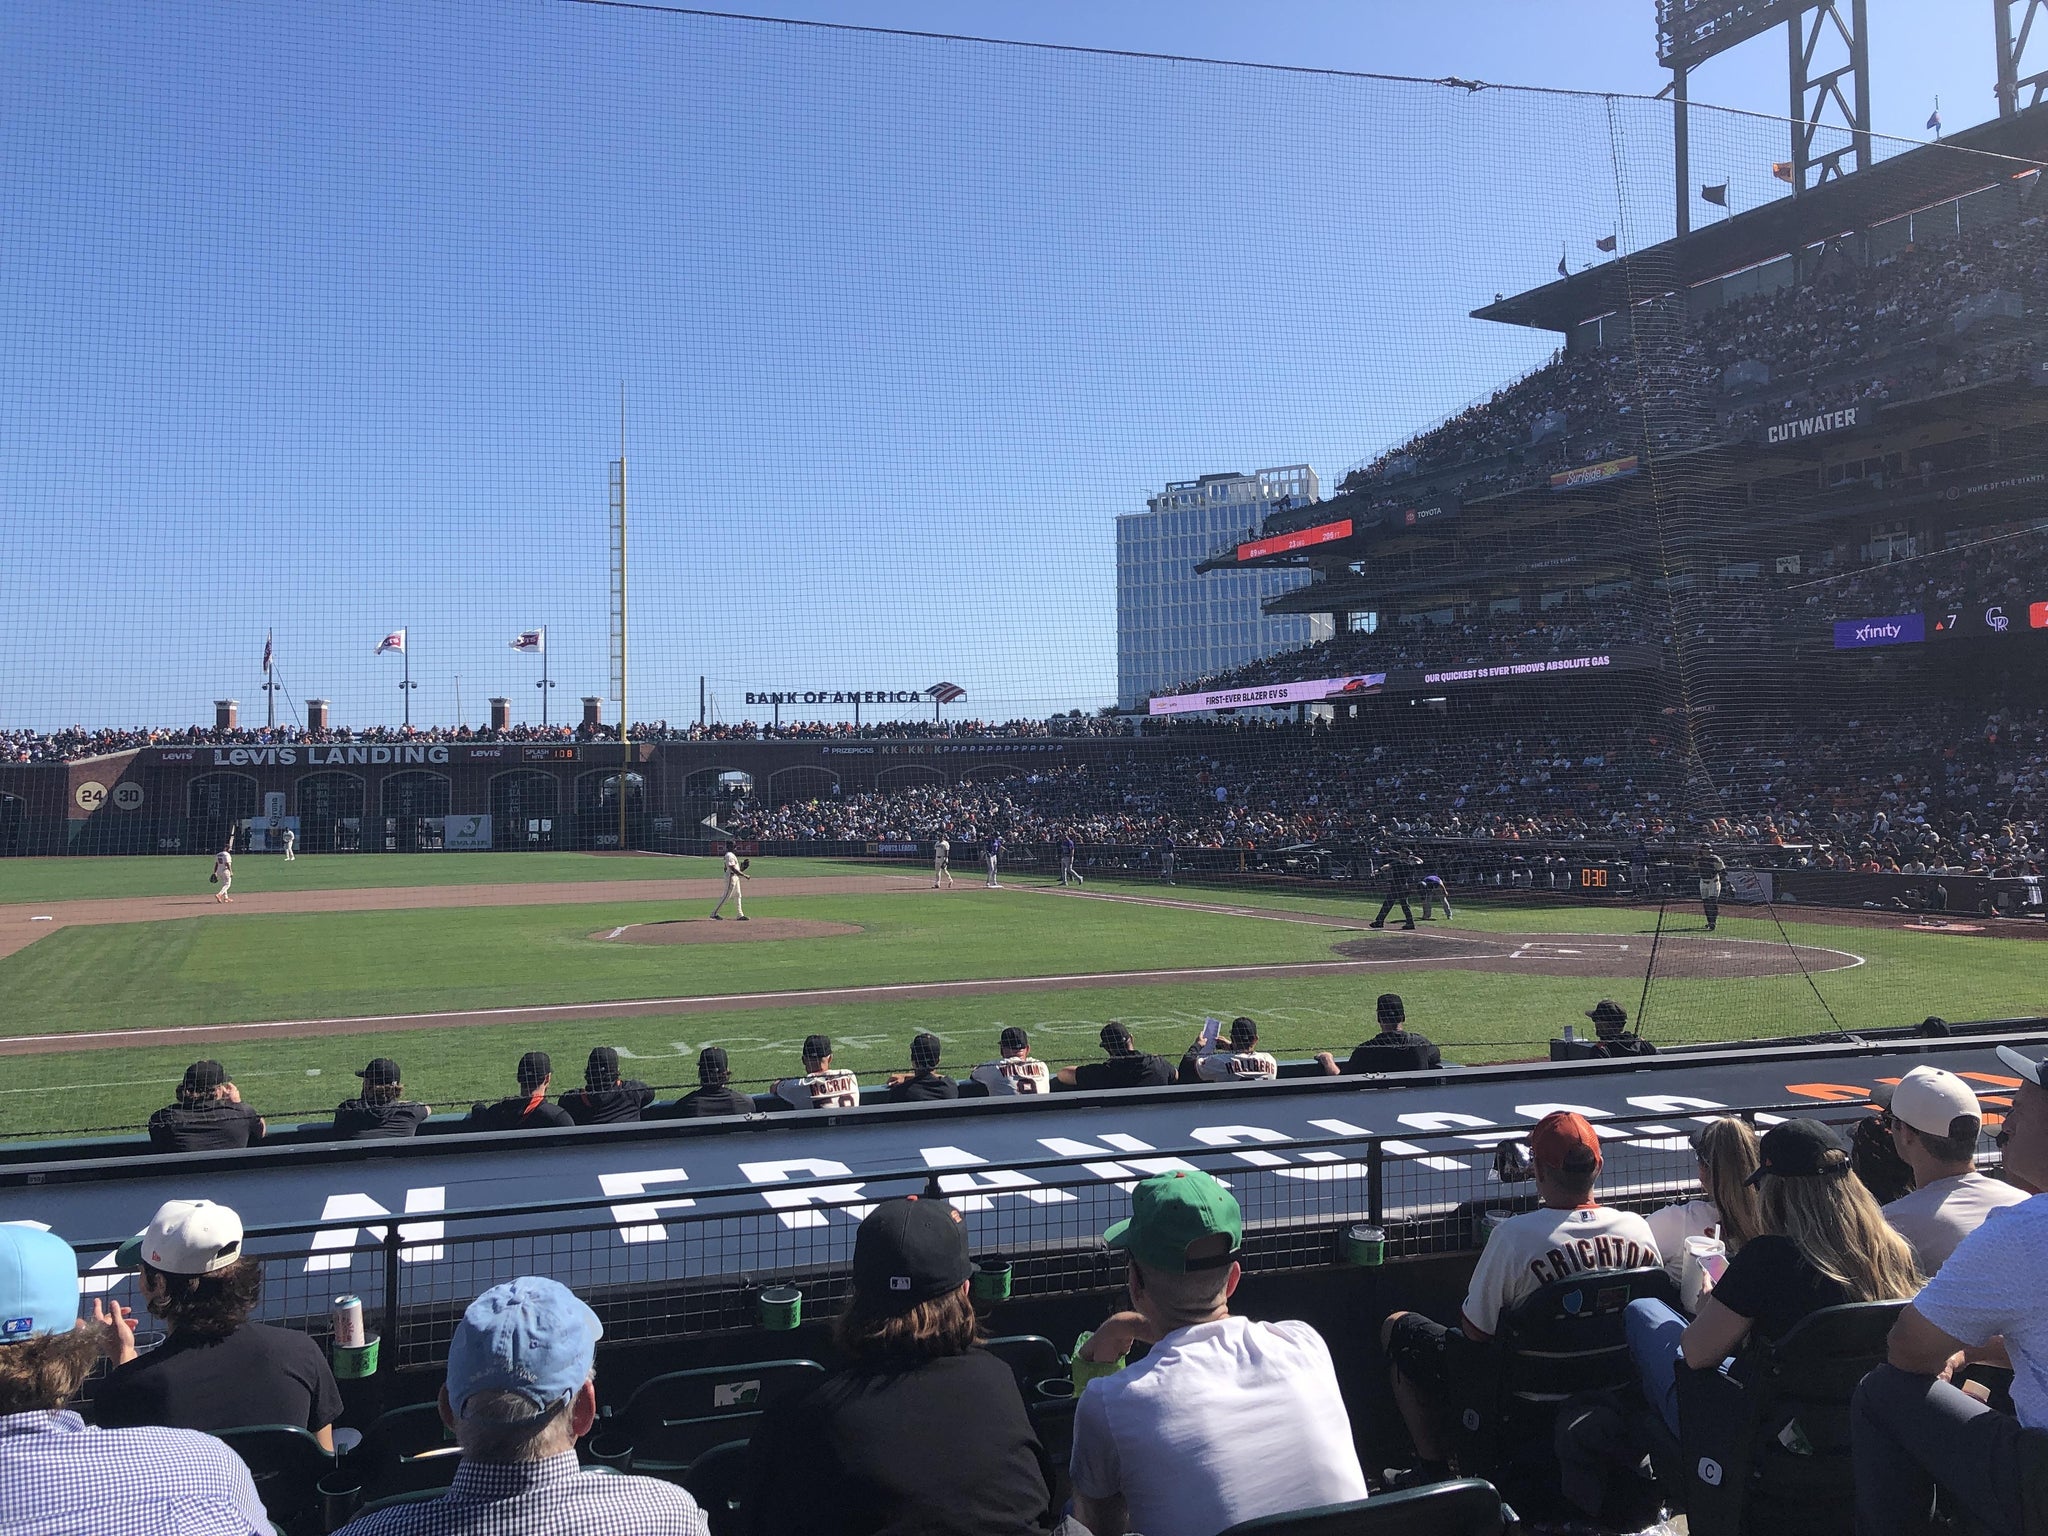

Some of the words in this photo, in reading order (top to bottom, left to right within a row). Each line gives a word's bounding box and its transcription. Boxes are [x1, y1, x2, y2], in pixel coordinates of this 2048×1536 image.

[1768, 407, 1856, 443] CUTWATER
[1566, 466, 1601, 486] Surfside
[1417, 507, 1442, 519] TOYOTA
[1947, 614, 1957, 629] 7
[1855, 623, 1901, 642] xfinity
[1425, 673, 1440, 683] OUR
[1441, 669, 1477, 682] QUICKEST
[1478, 668, 1488, 678] SS
[1489, 666, 1510, 676] EVER
[1510, 663, 1545, 674] THROWS
[1546, 658, 1590, 671] ABSOLUTE
[1592, 656, 1610, 666] GAS
[745, 692, 798, 704] BANK
[803, 692, 828, 704] OF
[833, 691, 920, 703] AMERICA
[1206, 693, 1242, 705] FIRST-EVER
[1242, 691, 1268, 703] BLAZER
[1269, 690, 1278, 699] EV
[1278, 688, 1288, 698] SS
[308, 747, 449, 764] LANDING
[81, 790, 104, 802] 24
[119, 790, 139, 802] 30
[160, 838, 180, 848] 365
[596, 834, 618, 844] 309
[878, 844, 898, 852] SPORTS
[898, 844, 918, 852] LEADER
[1000, 1064, 1045, 1078] WILLIAMS
[1224, 1058, 1275, 1074] HALLBERG
[810, 1077, 851, 1096] McCRAY
[1530, 1234, 1656, 1286] CRIGHTON
[1705, 1464, 1715, 1479] C
